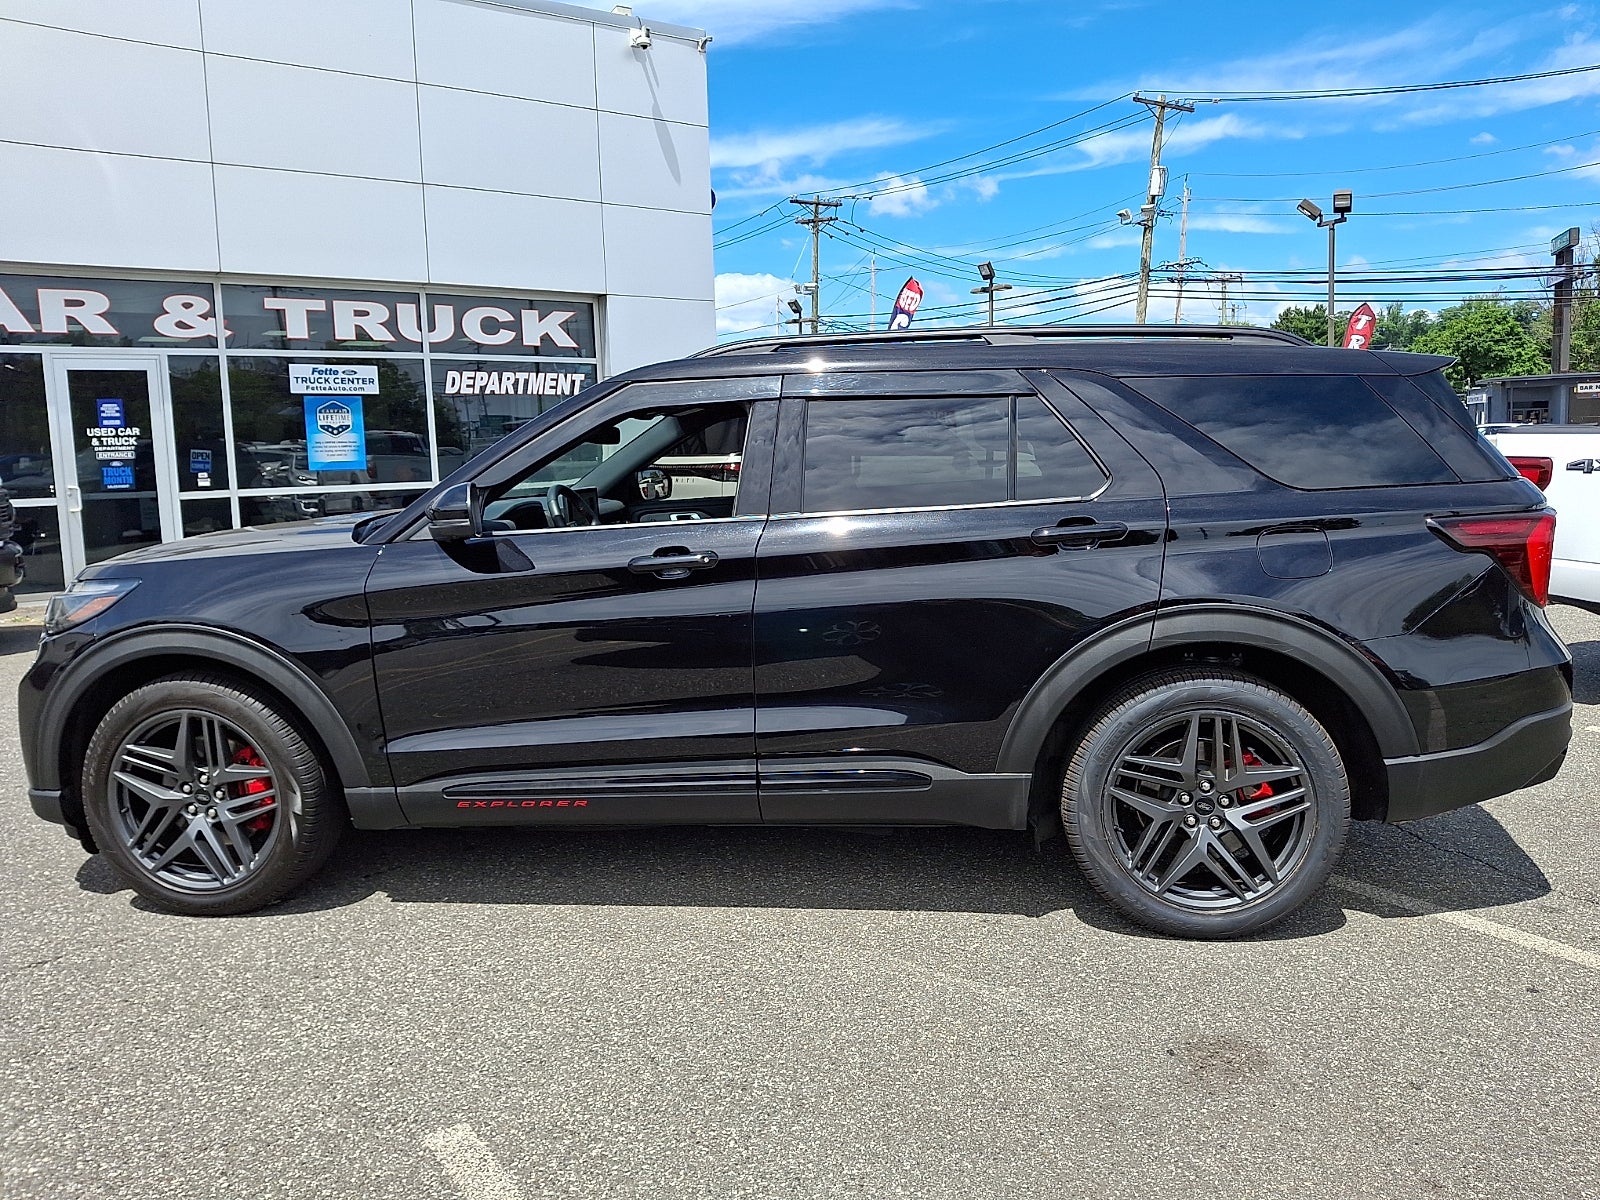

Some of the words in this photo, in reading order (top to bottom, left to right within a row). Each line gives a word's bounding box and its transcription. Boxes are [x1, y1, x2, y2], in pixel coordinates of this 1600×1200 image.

[153, 294, 233, 338] &
[263, 297, 580, 348] TRUCK
[311, 367, 339, 376] Fette
[294, 376, 331, 384] TRUCK
[333, 377, 375, 385] CENTER
[445, 370, 585, 396] DEPARTMENT
[86, 428, 117, 437] USED
[117, 427, 141, 436] CAR
[91, 437, 100, 446] &
[101, 437, 138, 446] TRUCK
[191, 451, 210, 460] OPEN
[102, 466, 132, 476] TRUCK
[103, 476, 133, 485] MONTH
[456, 800, 589, 808] EXPLORER
